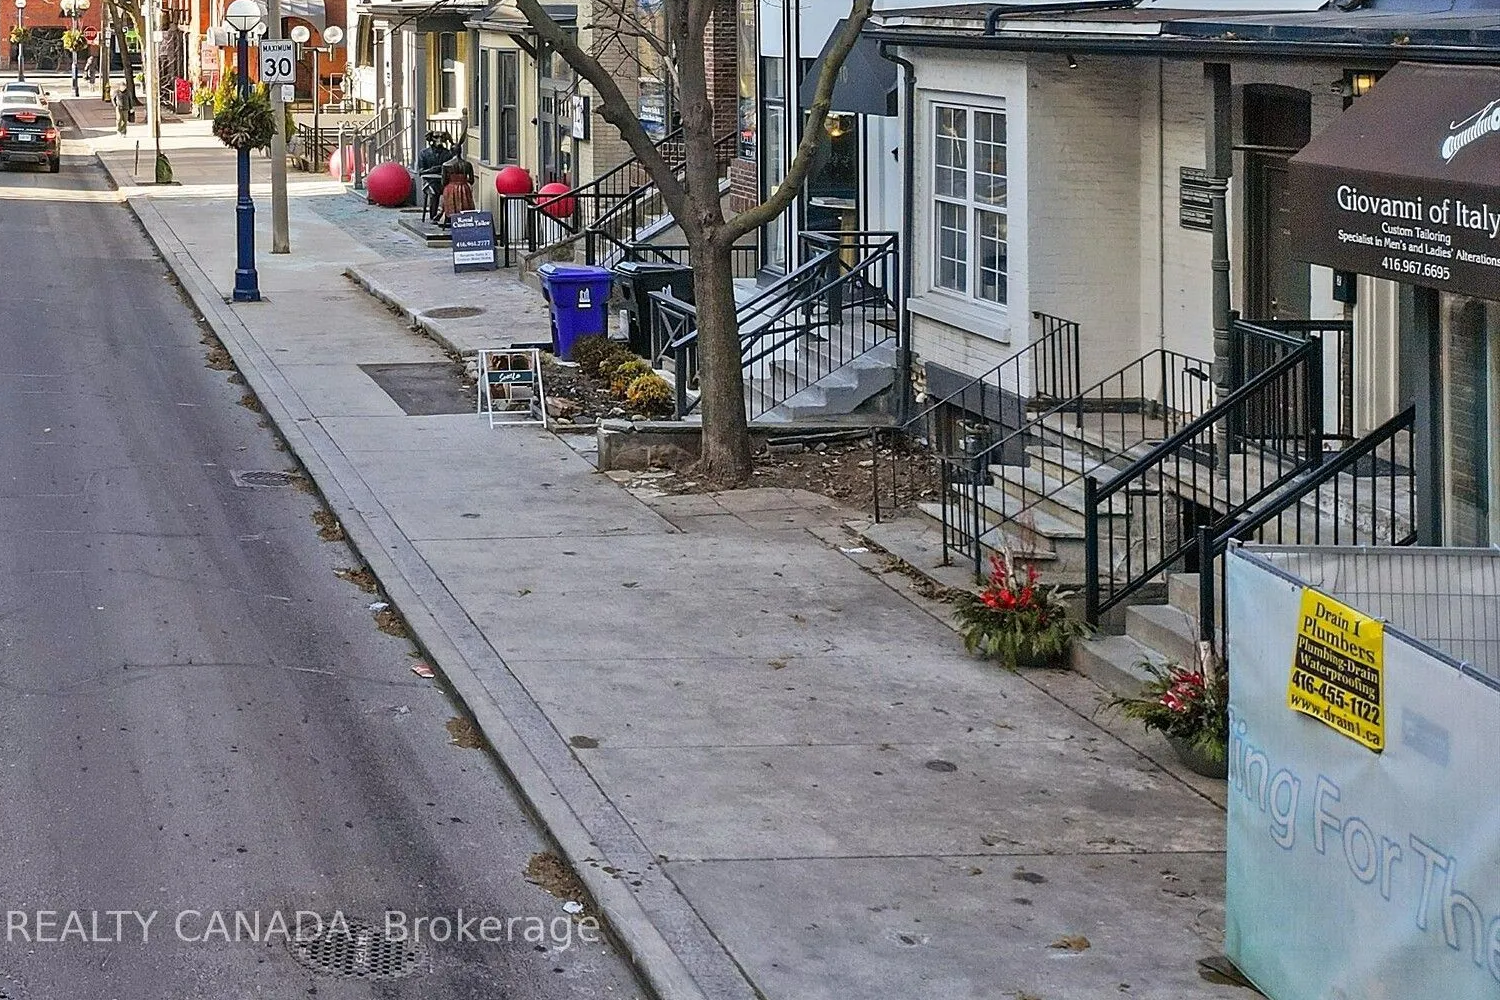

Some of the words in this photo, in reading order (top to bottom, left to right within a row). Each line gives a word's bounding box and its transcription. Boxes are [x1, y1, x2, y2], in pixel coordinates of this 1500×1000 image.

[262, 44, 292, 52] MAXIMUM
[264, 57, 292, 77] 30
[1336, 185, 1422, 221] Giovanni
[1429, 199, 1450, 225] of
[1456, 200, 1500, 239] Italy
[1381, 222, 1413, 238] Custom
[1414, 226, 1451, 246] Tailoring
[1338, 229, 1374, 246] Specialist
[1375, 235, 1382, 247] in
[1384, 237, 1406, 251] Men's
[1408, 242, 1423, 254] and
[1425, 243, 1453, 259] Ladies'
[1456, 249, 1500, 267] Alterations
[1381, 256, 1450, 280] 416.967.6695
[1302, 615, 1376, 664] Plumbers
[1315, 601, 1349, 632] Drain
[1299, 637, 1378, 684] Plumbing-Drain
[1299, 651, 1376, 700] Waterproofing
[1291, 669, 1381, 726] 416-455-1122
[1291, 693, 1380, 746] www.drain1.ca
[1313, 774, 1402, 901] For
